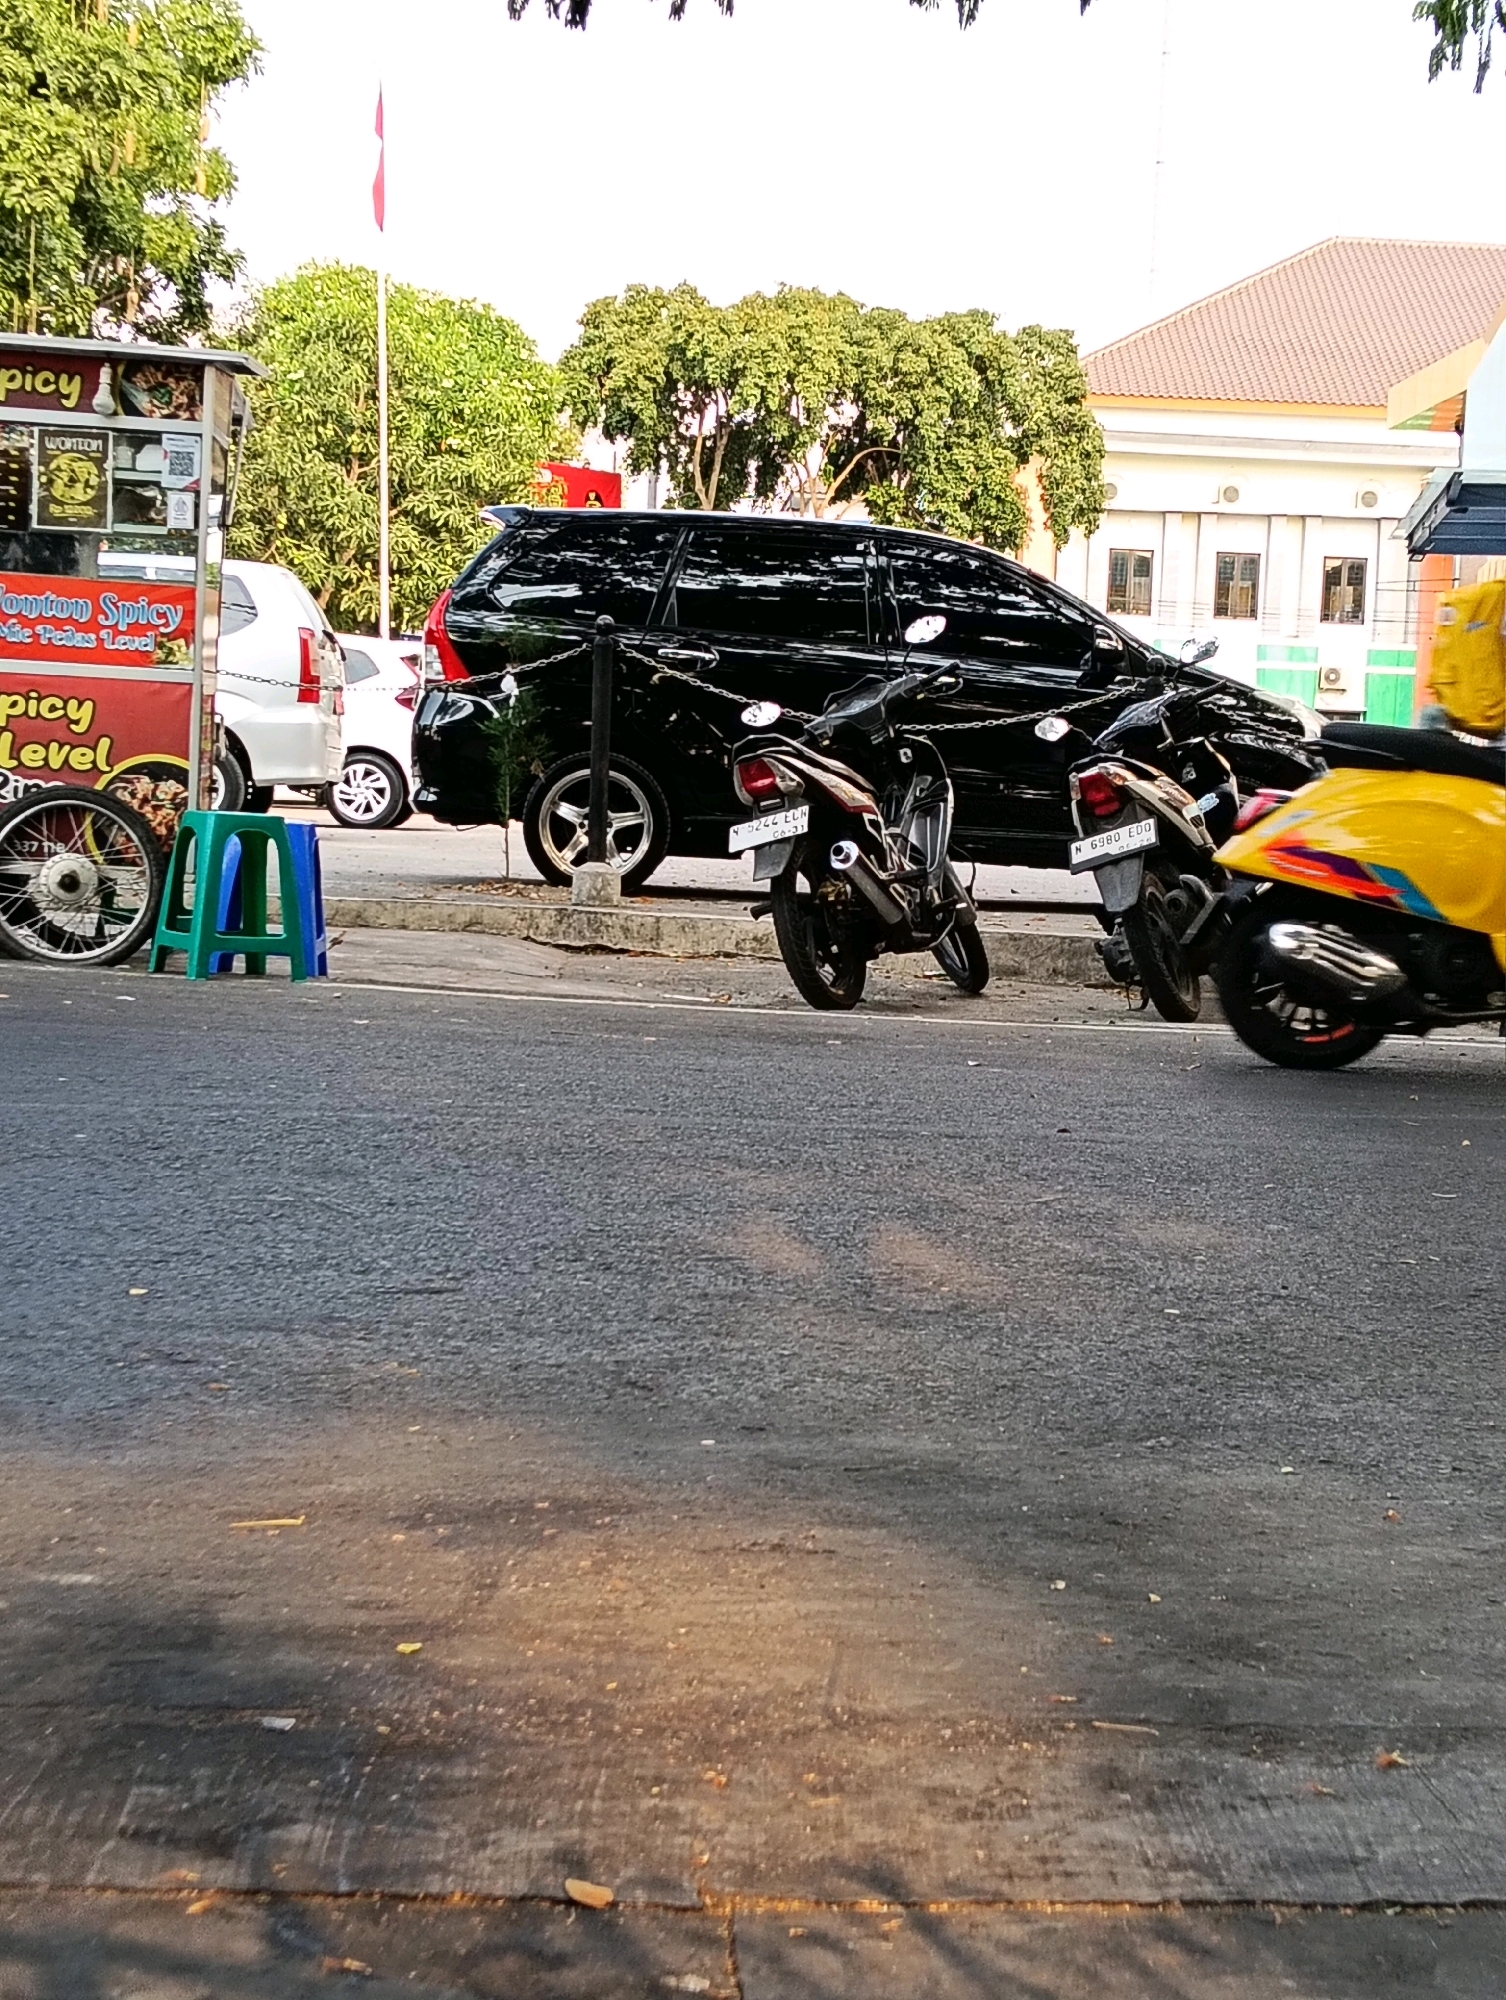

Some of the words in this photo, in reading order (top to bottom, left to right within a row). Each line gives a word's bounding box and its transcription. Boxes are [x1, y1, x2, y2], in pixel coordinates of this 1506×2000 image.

[0, 583, 92, 623] onton
[98, 592, 183, 633] Spicy
[34, 624, 97, 648] Pedas
[100, 630, 156, 651] Level
[0, 731, 112, 772] Level
[1075, 844, 1082, 856] N
[1090, 832, 1121, 850] 6980
